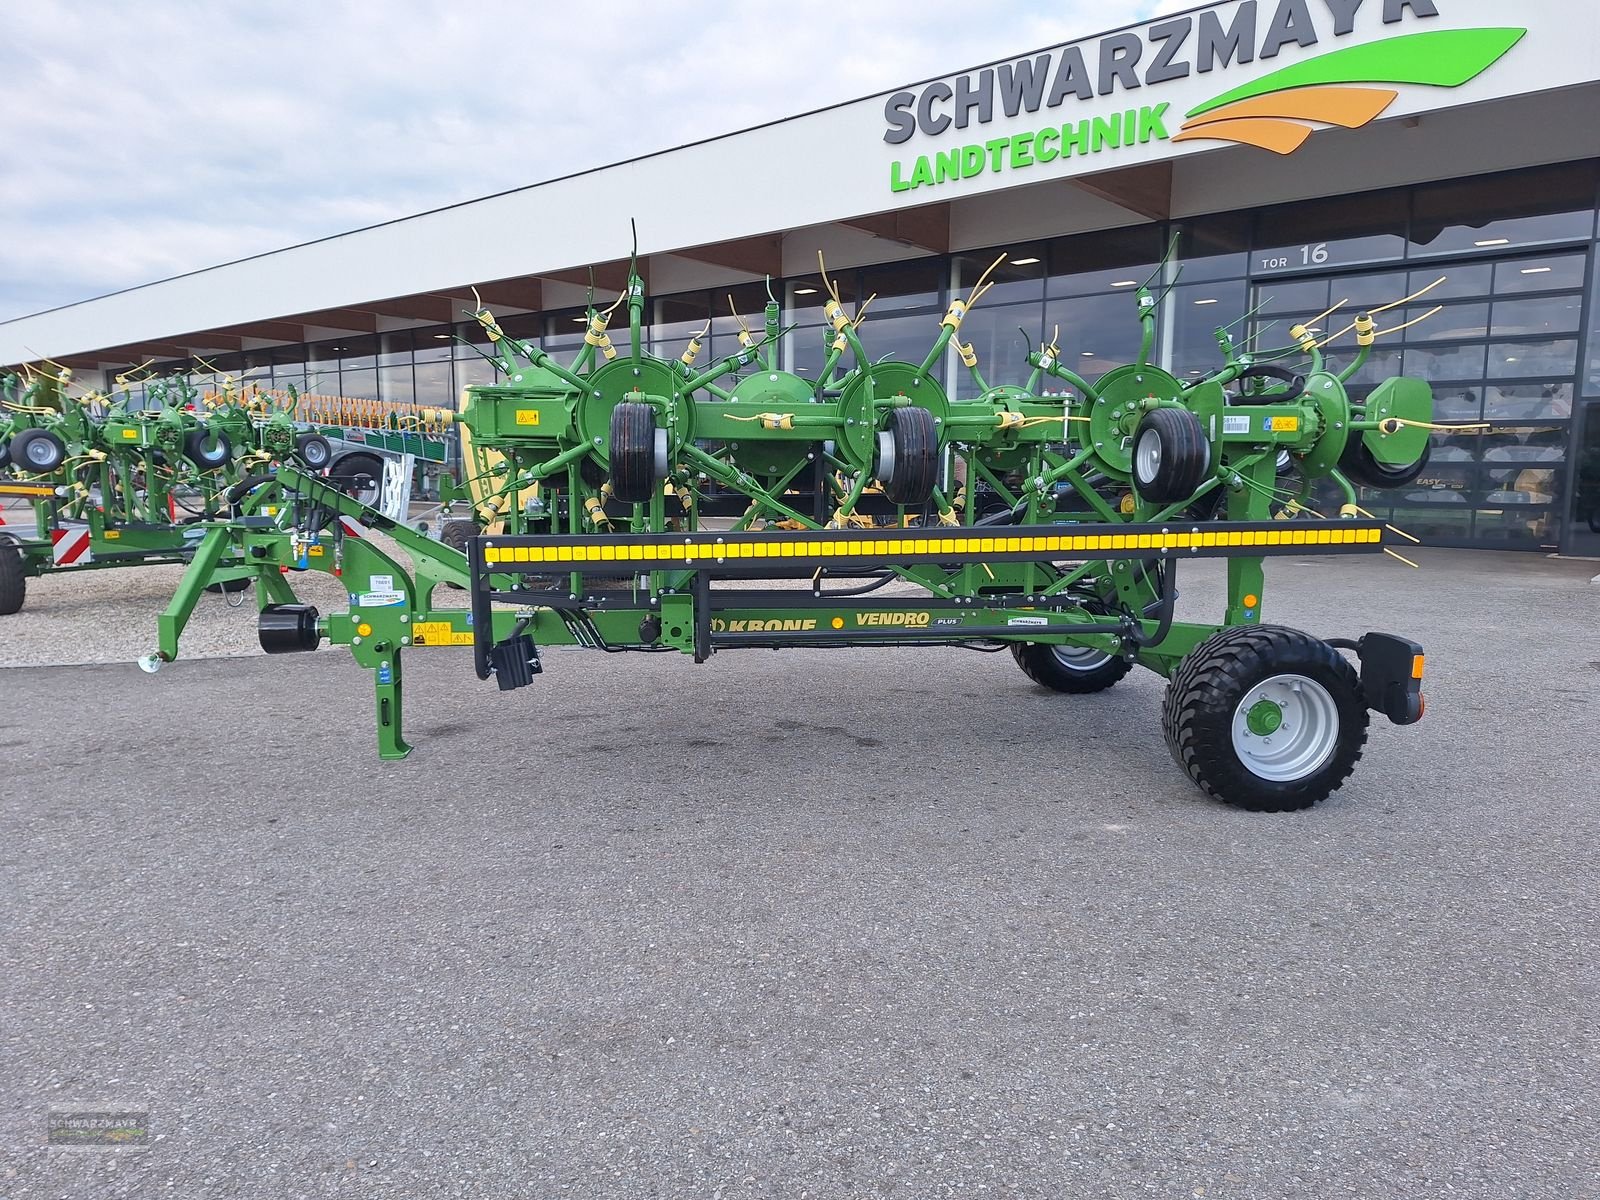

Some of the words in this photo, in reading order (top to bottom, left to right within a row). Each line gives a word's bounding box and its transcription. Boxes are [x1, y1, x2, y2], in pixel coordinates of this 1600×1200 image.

[890, 102, 1171, 193] LANDTECHNIK
[1262, 257, 1287, 269] TOR
[1300, 243, 1328, 265] 16
[856, 612, 930, 626] VENDRO
